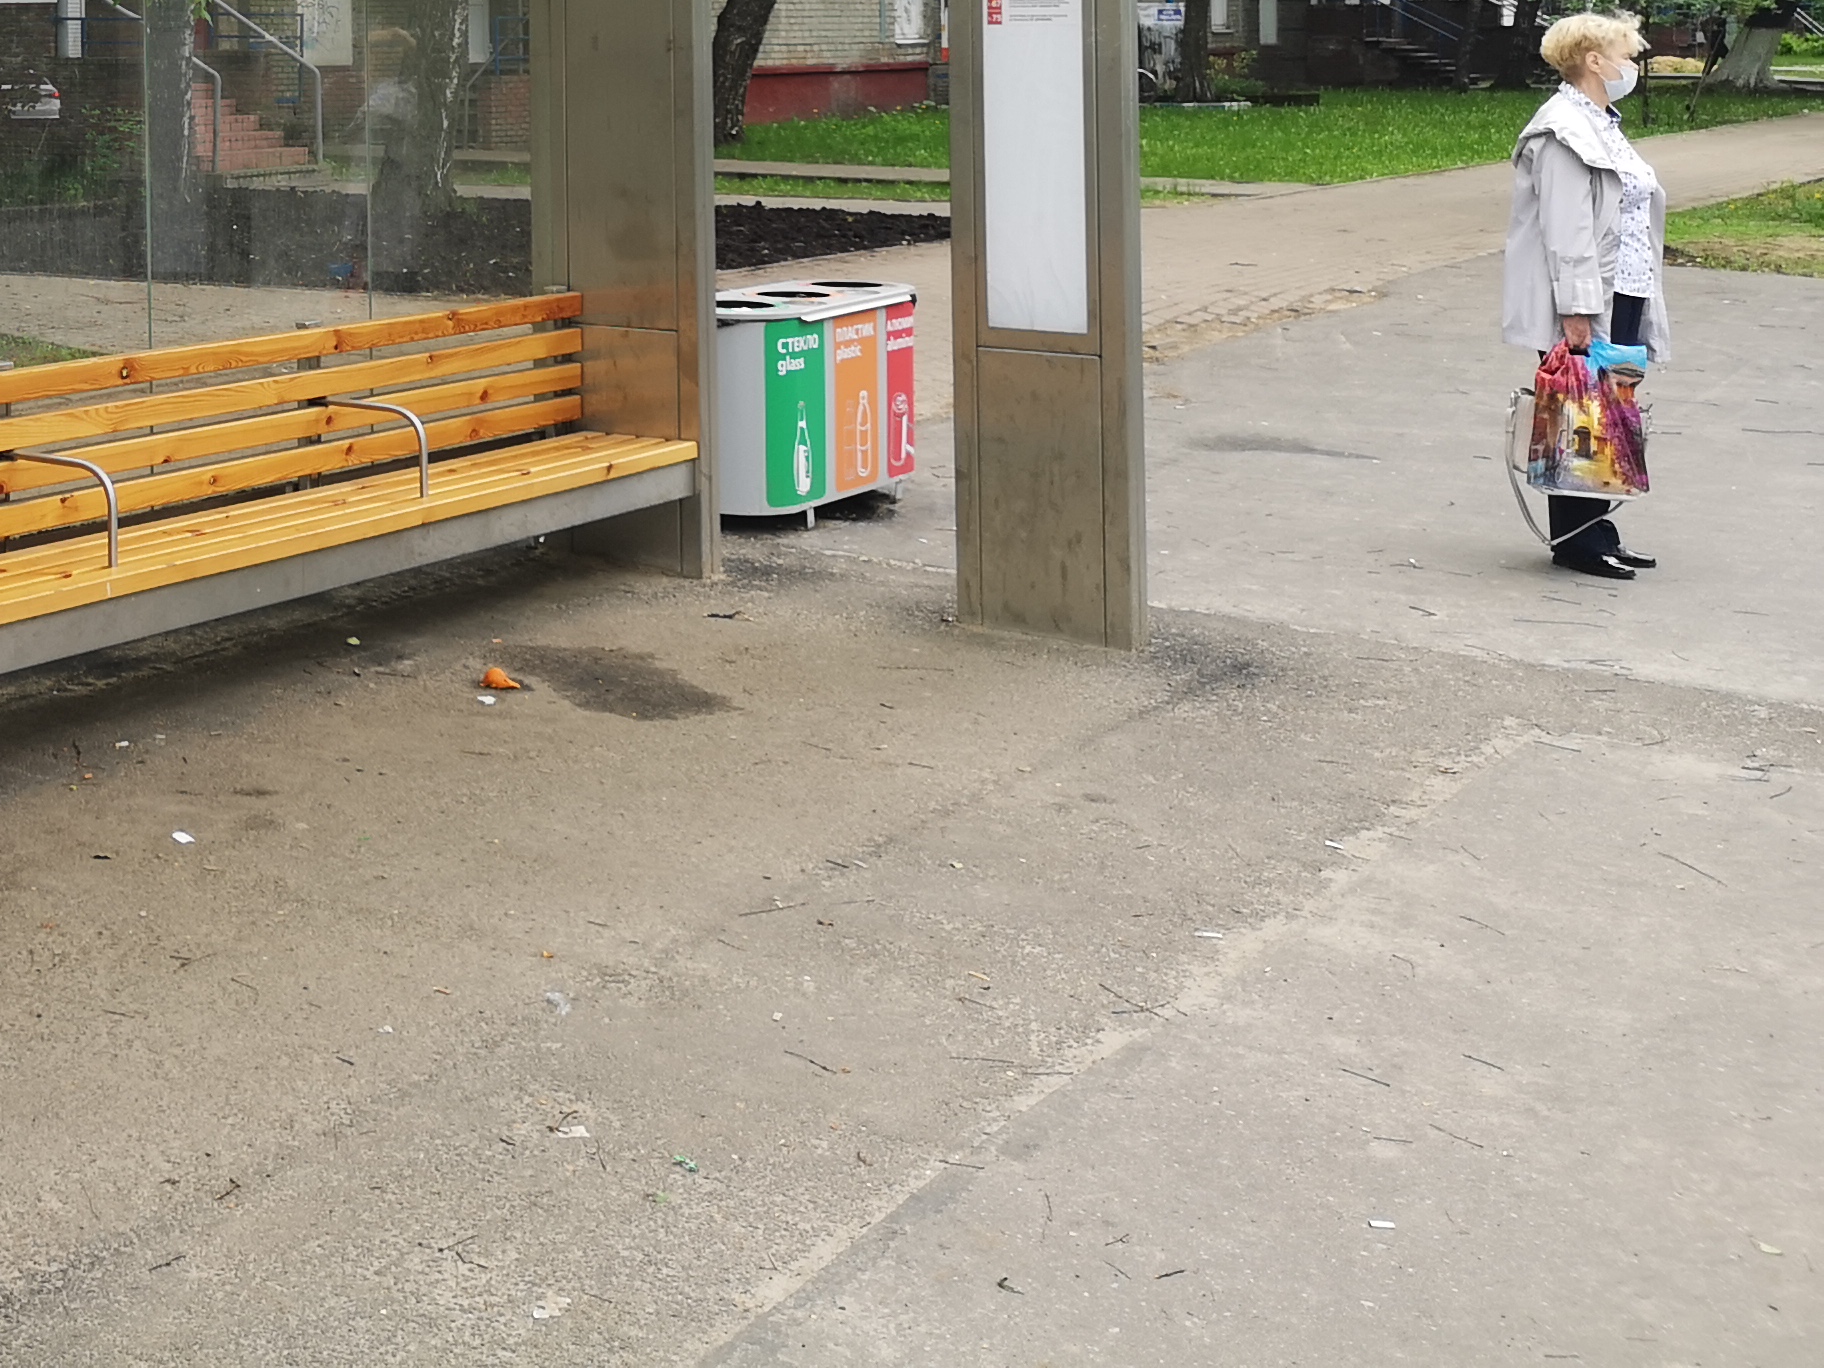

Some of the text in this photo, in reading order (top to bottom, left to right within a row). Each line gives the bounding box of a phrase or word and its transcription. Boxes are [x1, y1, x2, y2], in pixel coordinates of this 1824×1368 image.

[836, 322, 875, 342] ПЛАСТИК
[777, 333, 819, 354] СТЕКЛО
[836, 342, 863, 364] plastic
[777, 355, 805, 376] glass
